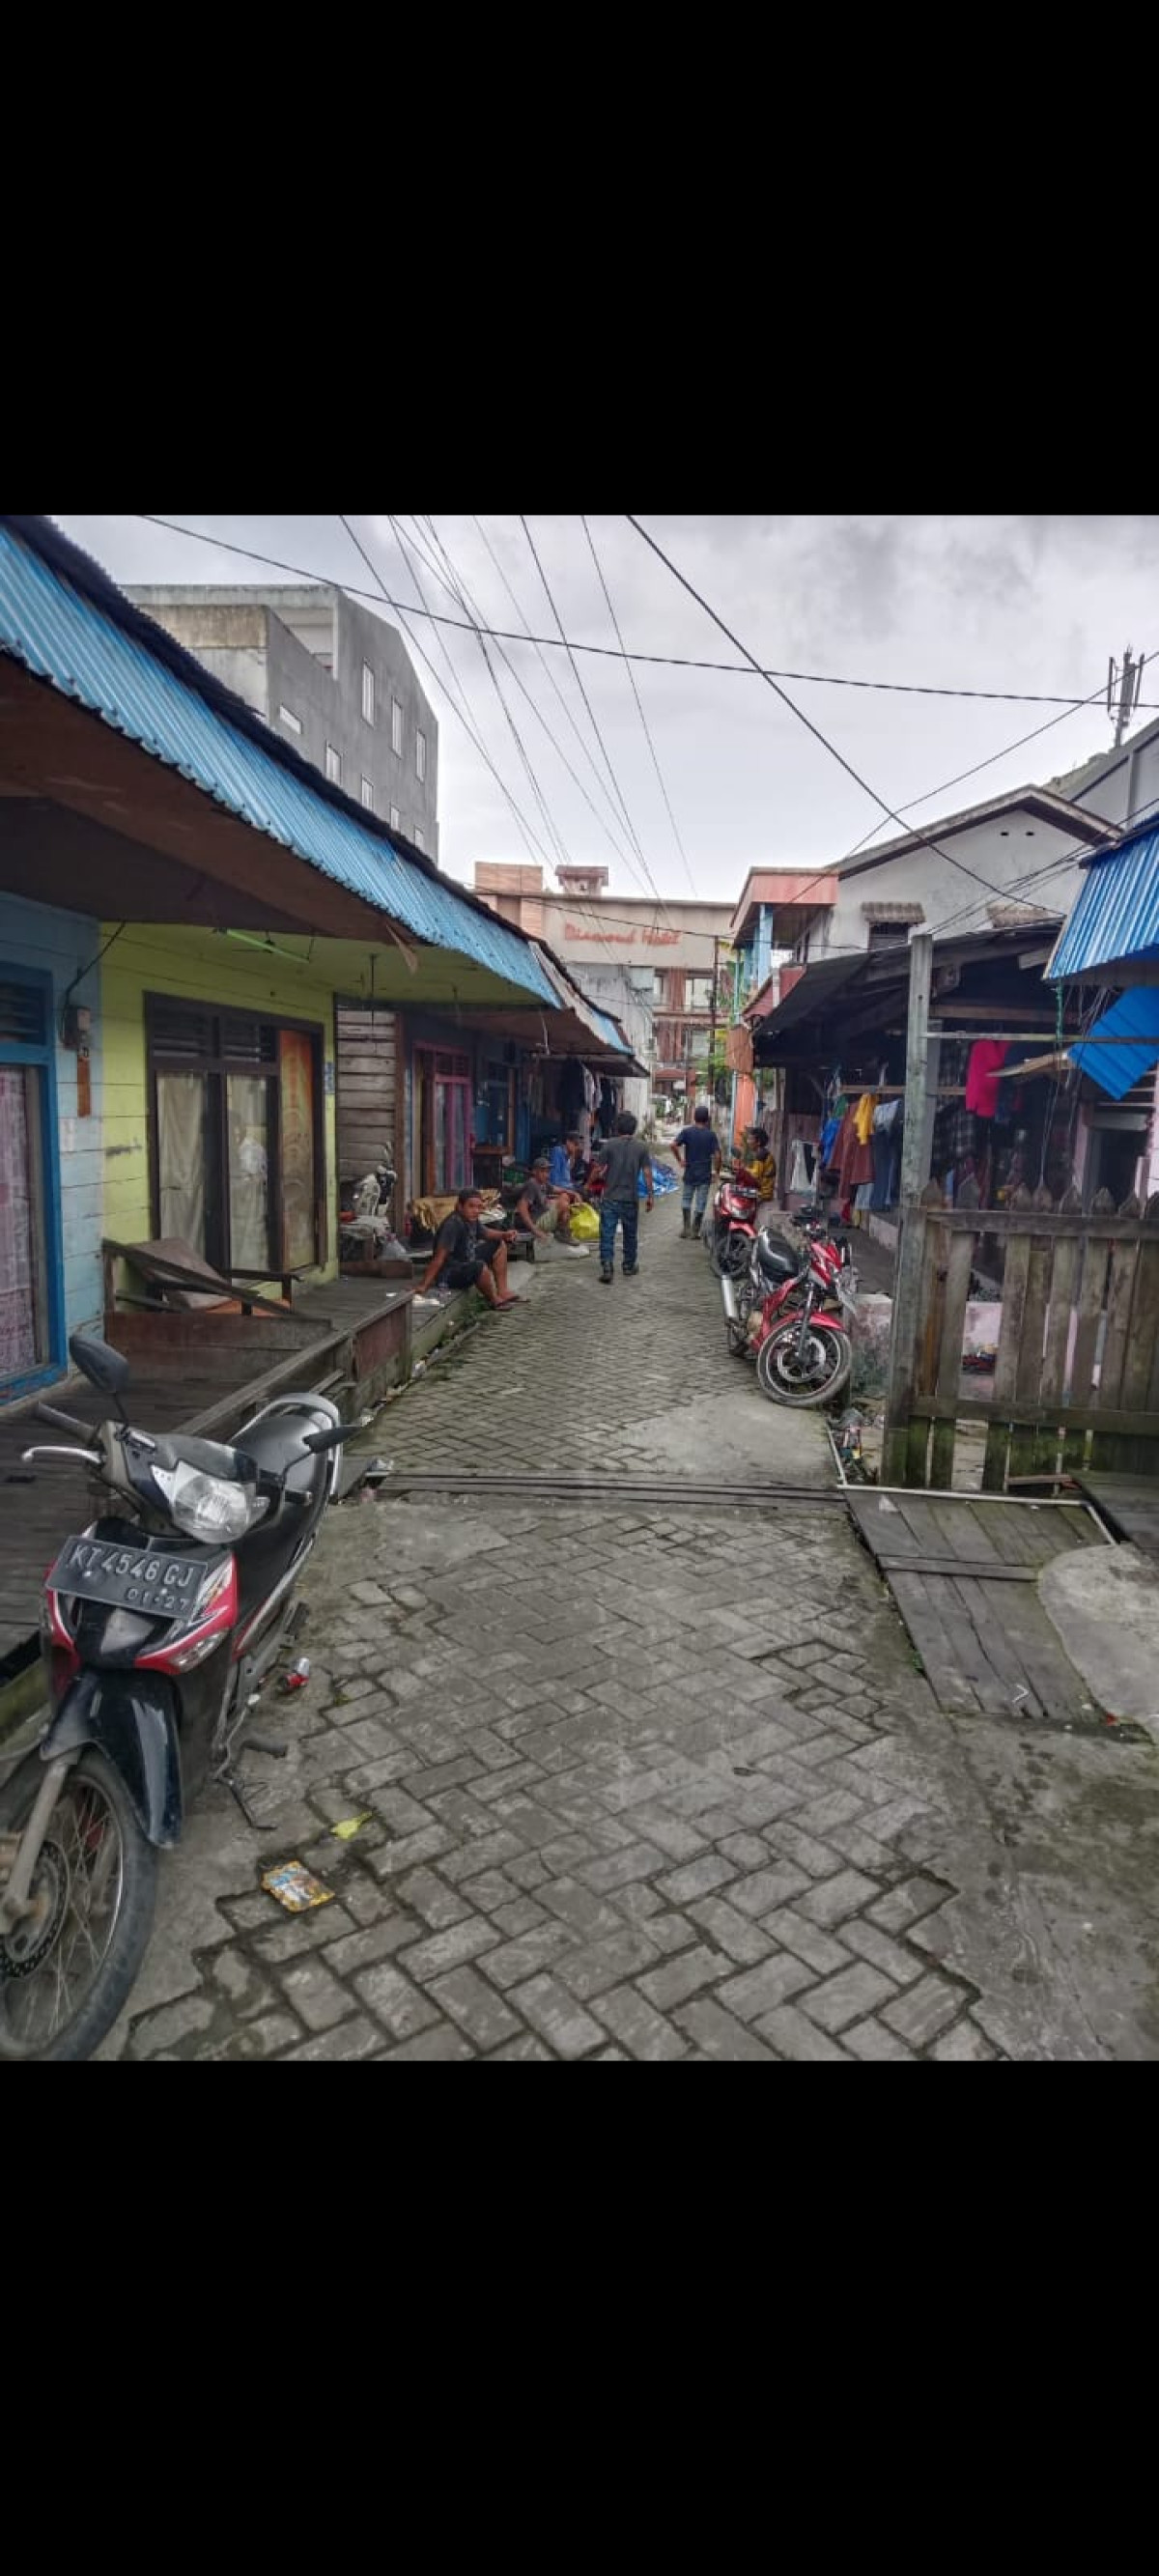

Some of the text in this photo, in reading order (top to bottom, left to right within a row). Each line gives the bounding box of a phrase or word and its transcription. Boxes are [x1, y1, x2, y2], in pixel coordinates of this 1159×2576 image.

[69, 1545, 194, 1587] KT 4546 GJ
